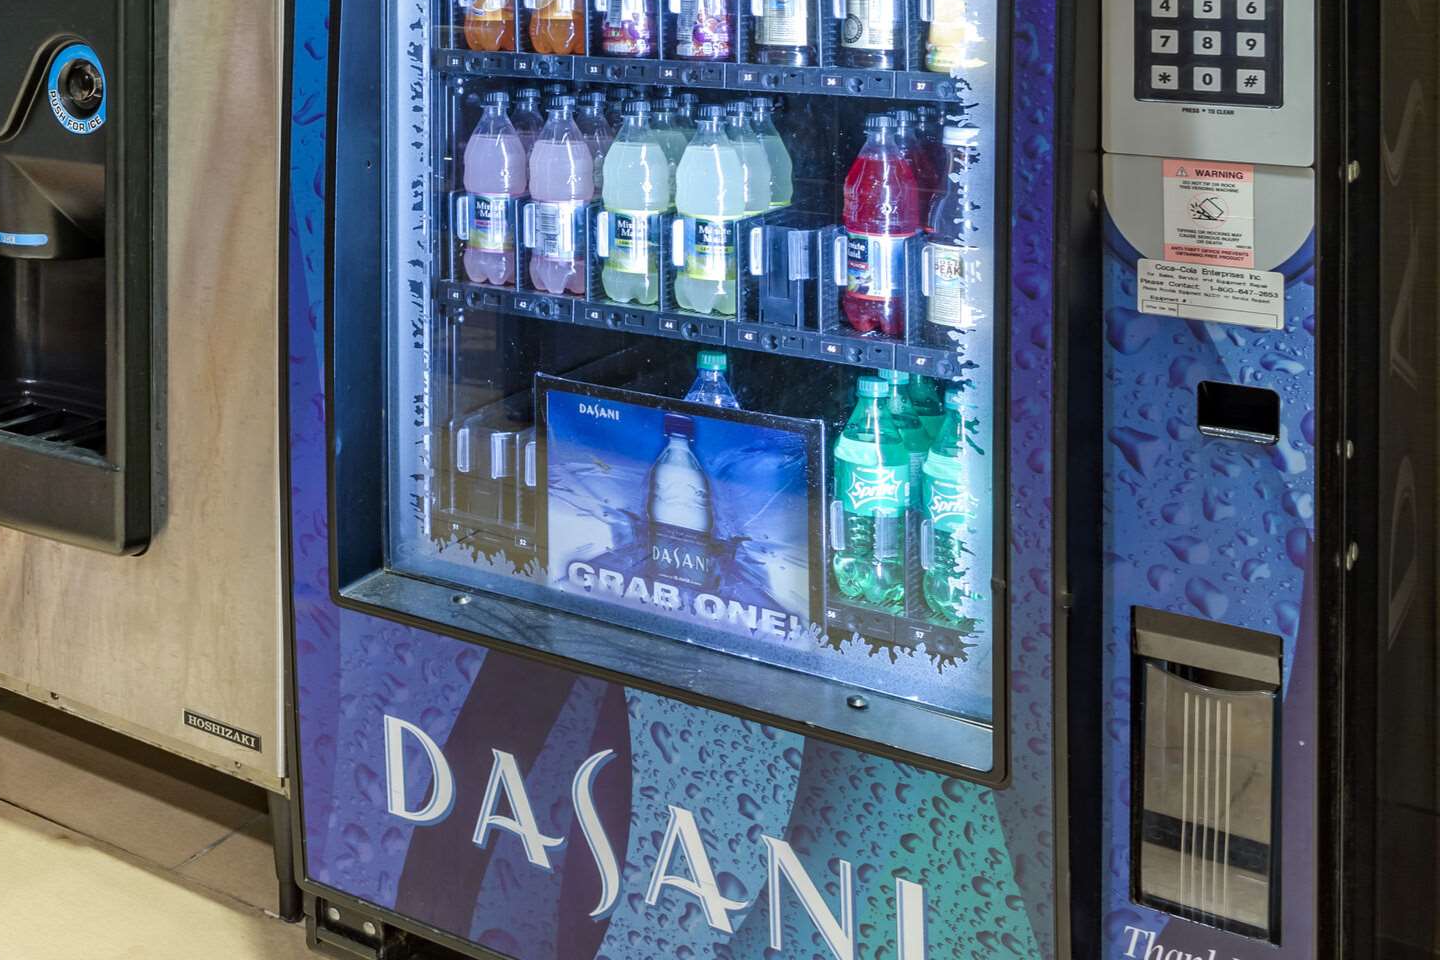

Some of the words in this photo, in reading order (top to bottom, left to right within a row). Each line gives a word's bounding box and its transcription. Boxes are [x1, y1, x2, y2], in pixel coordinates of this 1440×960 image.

[1160, 0, 1170, 12] 4
[1202, 1, 1213, 12] 5
[1246, 2, 1257, 14] 6
[1160, 36, 1171, 48] 7
[1202, 37, 1213, 49] 8
[1246, 39, 1257, 50] 9
[1202, 73, 1213, 86] 0
[50, 90, 66, 121] PUSH
[67, 119, 85, 131] FOR
[88, 116, 101, 129] ICE
[1195, 169, 1244, 180] WARNING
[1155, 264, 1198, 274] Coca-Cola
[1202, 268, 1244, 279] Enterprises
[664, 321, 673, 329] 44
[579, 402, 621, 421] DASANI
[568, 562, 682, 610] GRAB
[694, 593, 800, 641] ONE!
[188, 714, 256, 747] HOSHIZAKI
[382, 714, 928, 959] DASANI
